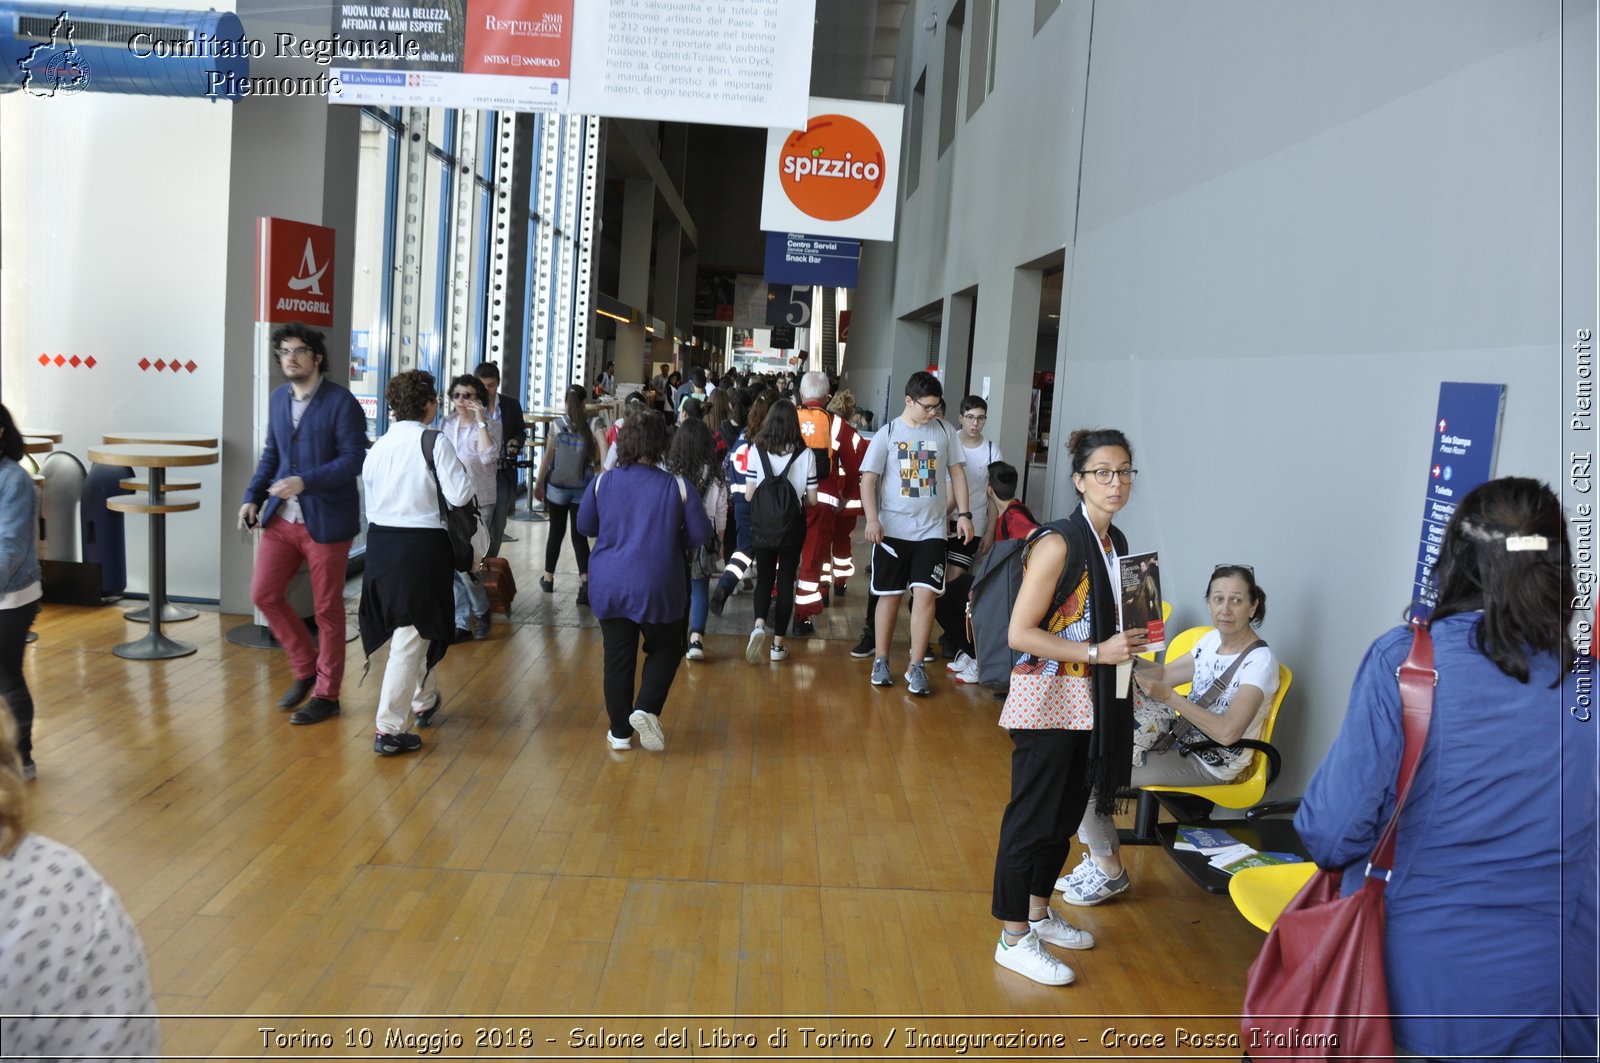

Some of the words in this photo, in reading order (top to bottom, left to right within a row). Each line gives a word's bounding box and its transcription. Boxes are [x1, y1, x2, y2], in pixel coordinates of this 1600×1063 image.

[342, 5, 368, 17] NUOVA
[371, 6, 390, 18] LUCE
[392, 7, 411, 19] ALLA
[413, 8, 451, 21] BELLEZZA,
[645, 1, 701, 12] salvaguardia
[718, 5, 726, 14] la
[732, 7, 758, 16] tutela
[763, 8, 778, 17] del
[341, 18, 378, 30] AFFIDATA
[379, 20, 386, 31] A
[388, 20, 408, 32] MANI
[410, 22, 446, 34] ESPERTE.
[542, 13, 563, 24] 2018
[609, 10, 660, 21] patrimonio
[665, 15, 702, 25] artistico
[708, 17, 722, 26] del
[763, 20, 777, 29] Tra
[608, 22, 616, 30] le
[620, 22, 638, 32] 212
[643, 26, 669, 35] opere
[673, 28, 719, 39] restaurate
[723, 30, 738, 39] nel
[741, 31, 776, 42] biennio
[608, 34, 658, 46] 2016/2017
[672, 39, 712, 50] riportate
[716, 42, 732, 51] alla
[736, 43, 775, 54] pubblica
[421, 50, 439, 61] delle
[440, 51, 454, 62] Arti
[484, 55, 509, 65] INTESA
[607, 46, 649, 59] fruizione,
[651, 49, 680, 60] dipinti
[682, 50, 691, 60] di
[693, 52, 727, 64] Tiziano,
[730, 55, 747, 65] Van
[749, 56, 774, 67] Dyck,
[606, 59, 632, 69] Pietro
[637, 61, 649, 70] da
[654, 62, 692, 74] Cortona
[709, 66, 733, 76] Burri,
[739, 68, 773, 79] insieme
[617, 73, 662, 84] manufatti
[669, 76, 702, 86] artistici
[708, 79, 717, 87] di
[725, 80, 772, 91] importanti
[604, 84, 640, 96] maestri,
[643, 86, 652, 95] di
[655, 88, 676, 98] ogni
[679, 89, 711, 99] tecnica
[783, 149, 880, 182] spizzico
[787, 240, 811, 249] Centro
[813, 241, 837, 250] Servizi
[785, 253, 808, 263] Snack
[809, 255, 821, 264] Bar
[276, 298, 330, 315] AUTOGRILL
[786, 285, 811, 326] 5
